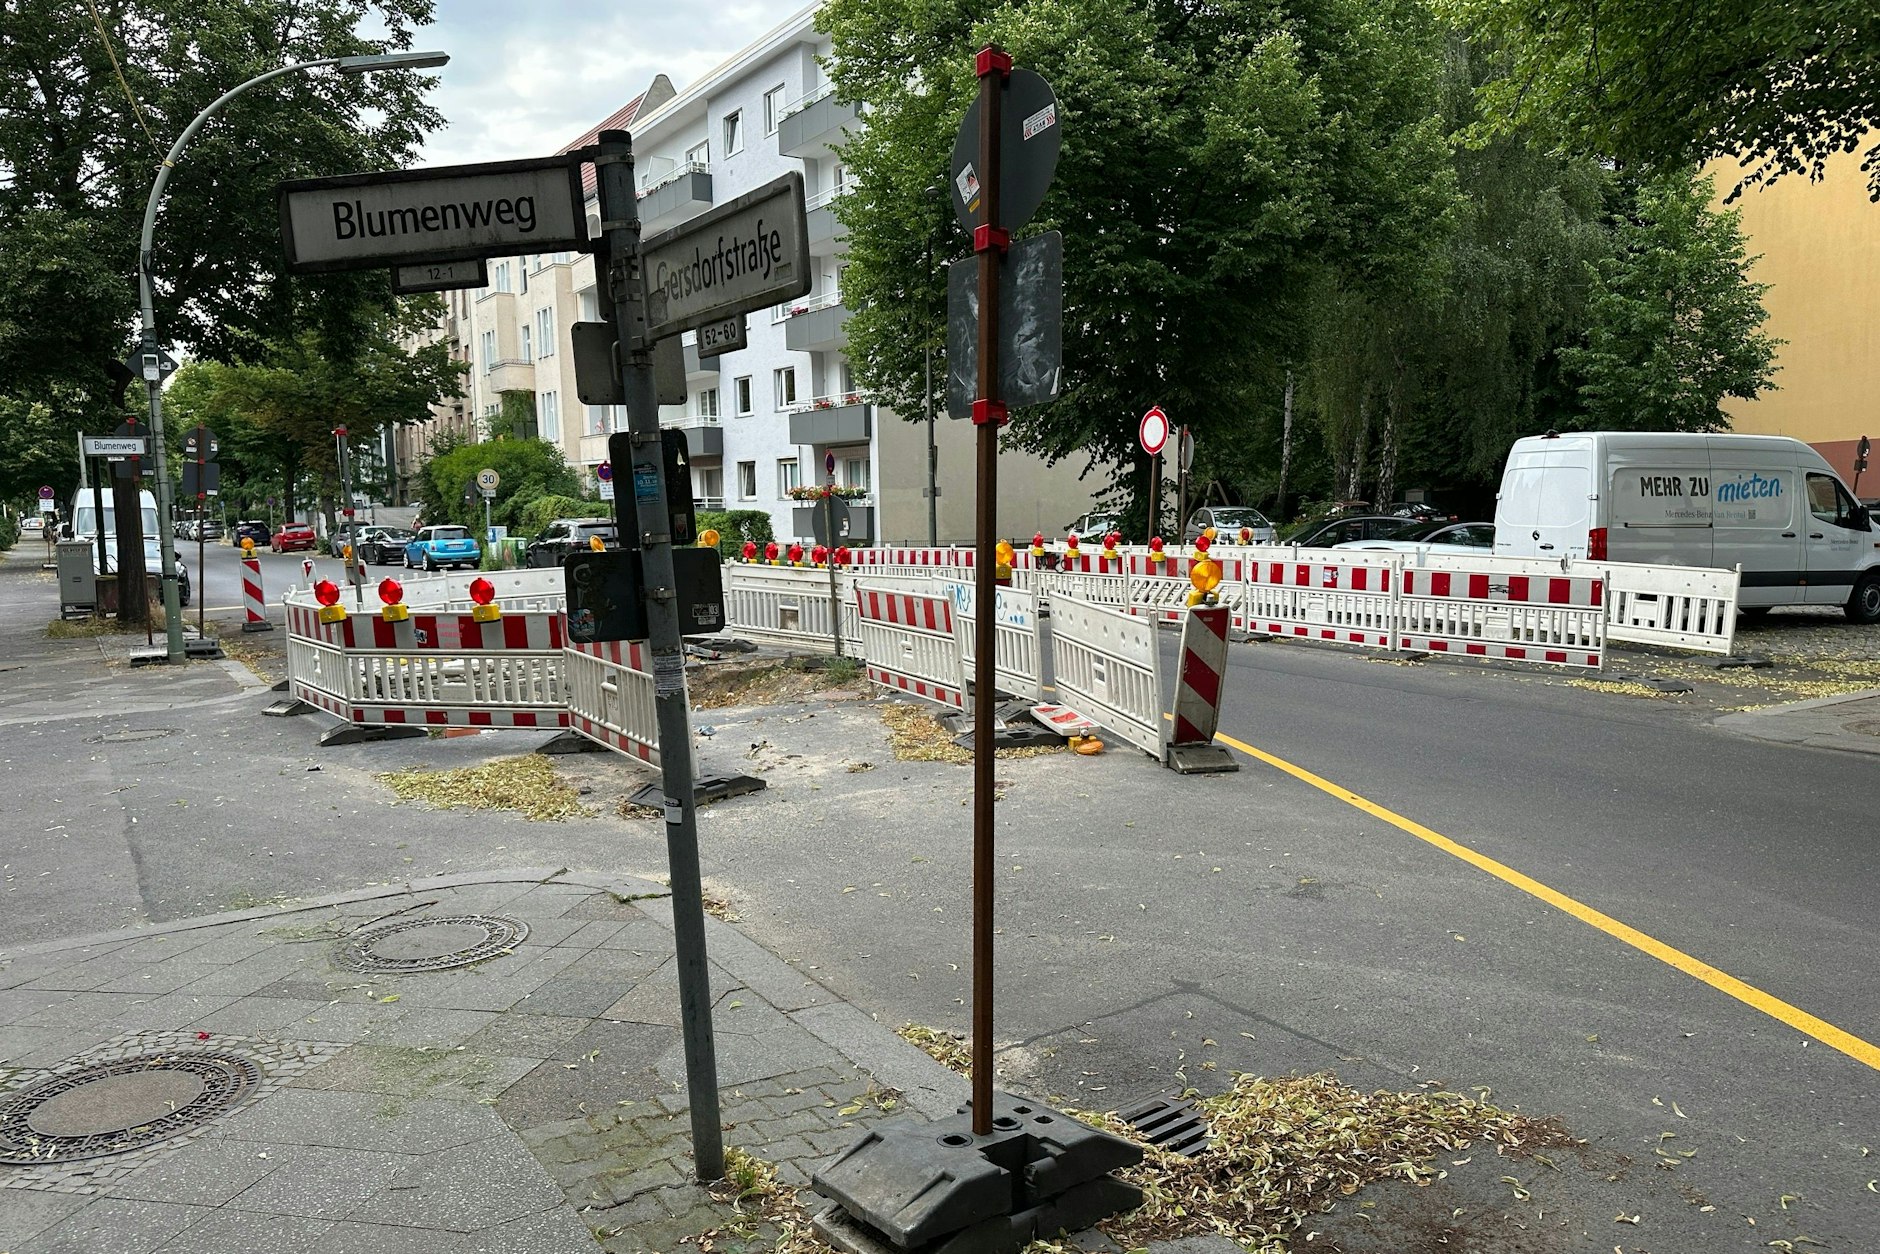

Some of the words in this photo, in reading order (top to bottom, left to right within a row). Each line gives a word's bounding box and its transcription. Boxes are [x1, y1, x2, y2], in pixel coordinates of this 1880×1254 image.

[333, 195, 537, 240] Blumenweg
[656, 219, 781, 303] Gersdorfstraße
[427, 267, 453, 280] 12-1
[705, 322, 736, 346] 52-60
[94, 441, 137, 451] Blumenweg
[482, 474, 495, 484] 30
[1640, 476, 1682, 497] MEHR
[1689, 477, 1709, 497] ZU
[1717, 473, 1783, 502] mieten.
[1665, 510, 1713, 519] Mercedes-Benz
